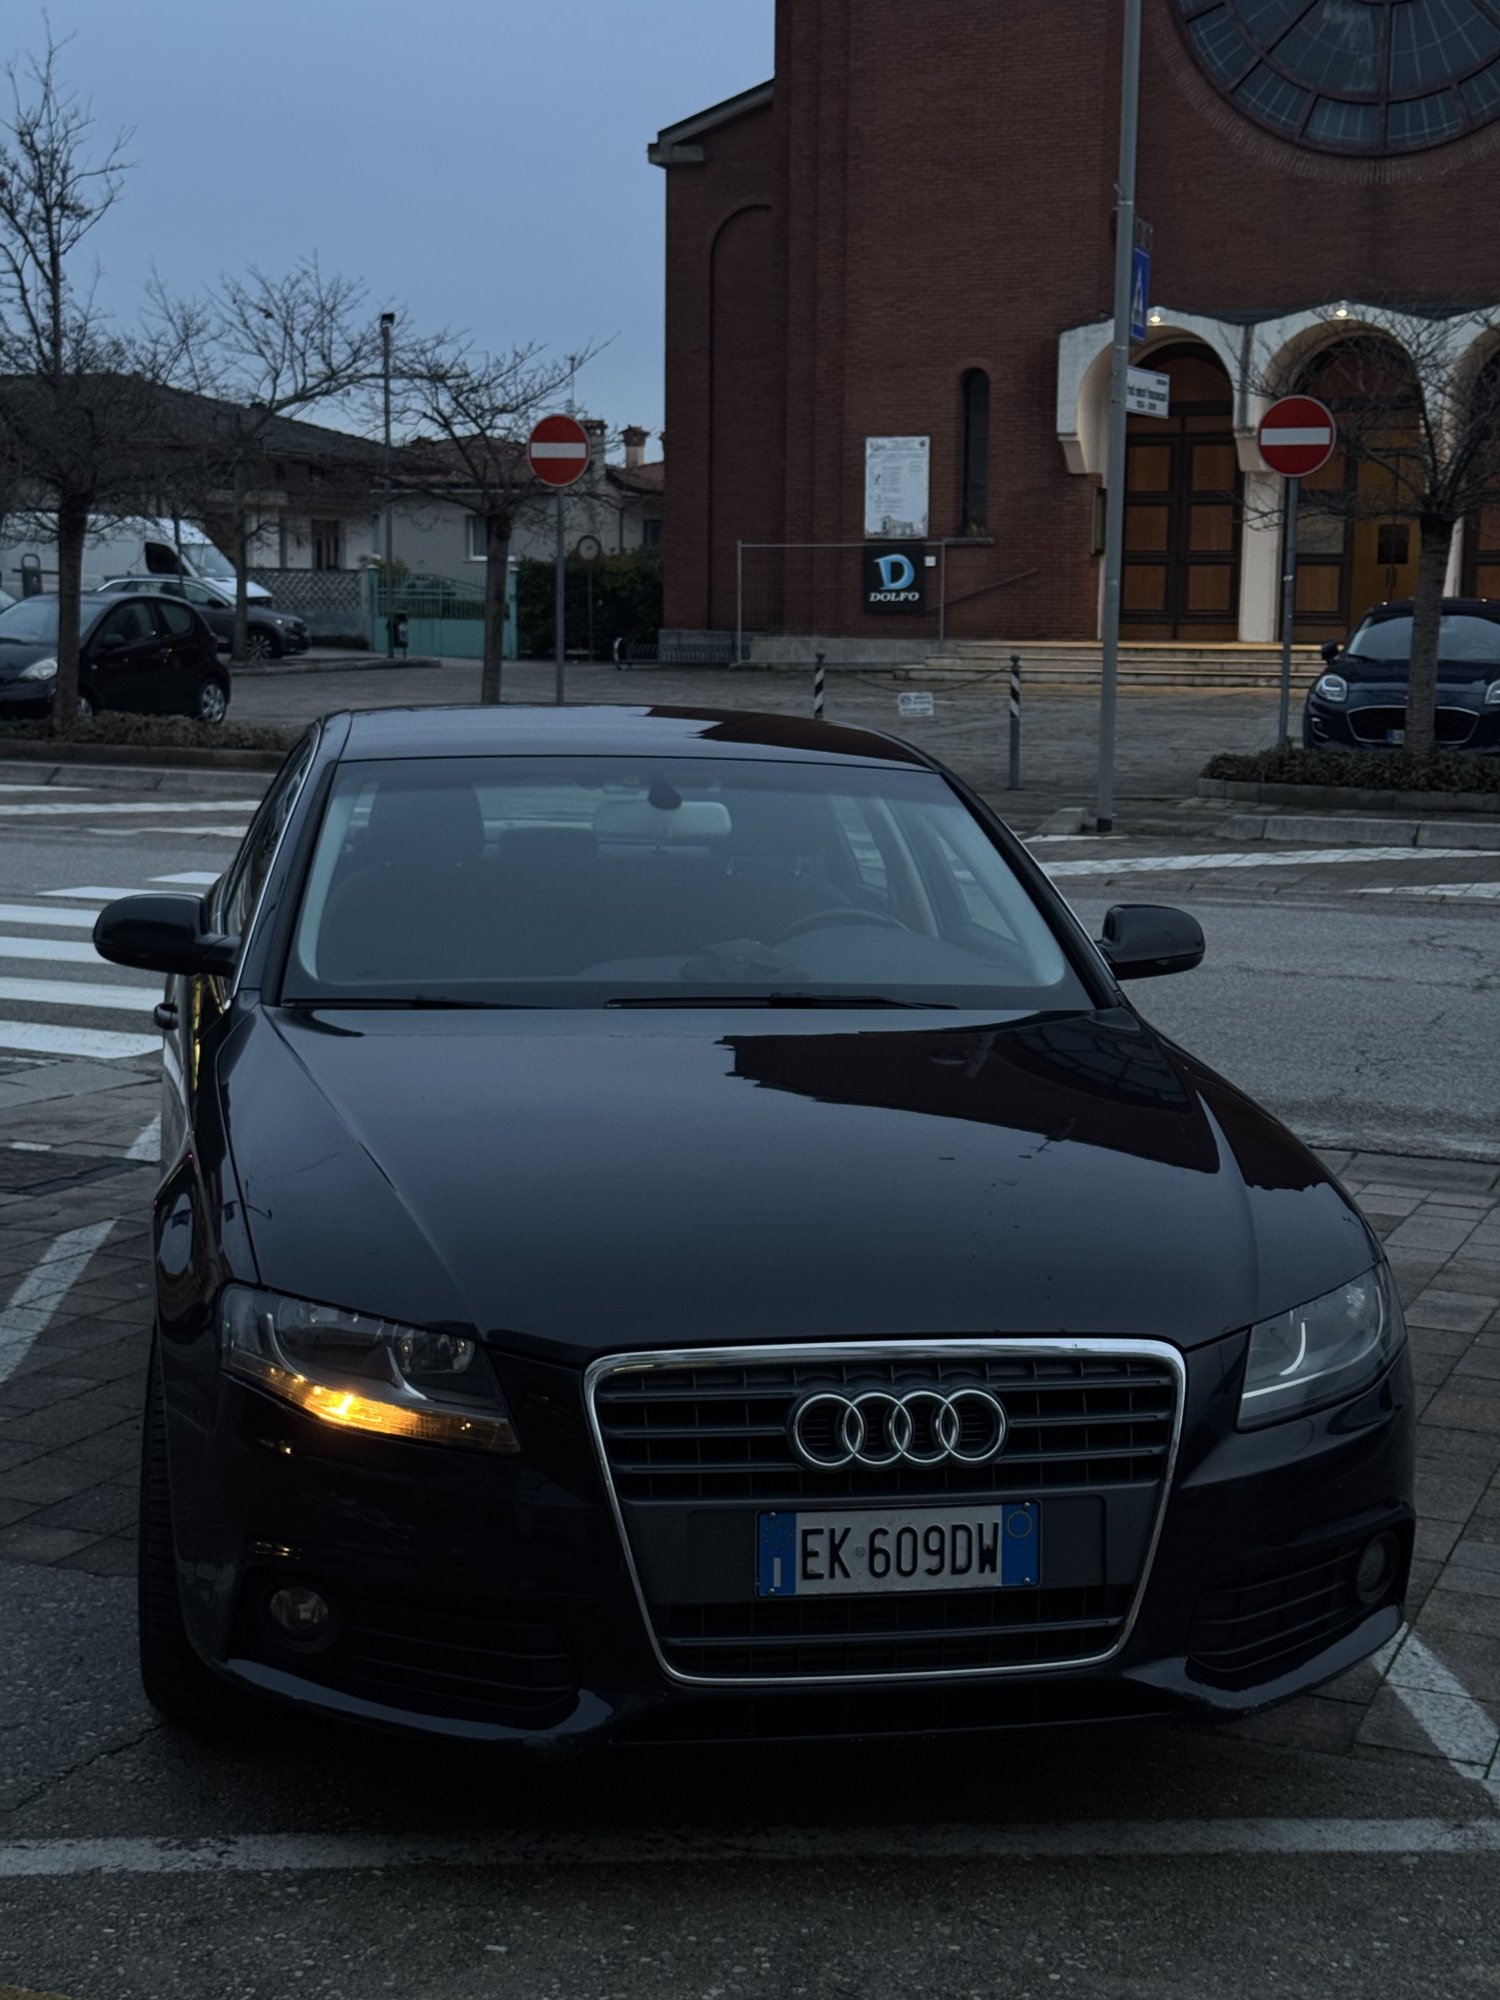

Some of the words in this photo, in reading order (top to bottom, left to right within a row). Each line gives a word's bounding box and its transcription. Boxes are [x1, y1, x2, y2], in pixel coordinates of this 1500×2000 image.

[873, 553, 915, 590] D
[870, 592, 920, 602] DOLFO
[801, 1527, 851, 1580] EK
[868, 1522, 999, 1578] 609DW
